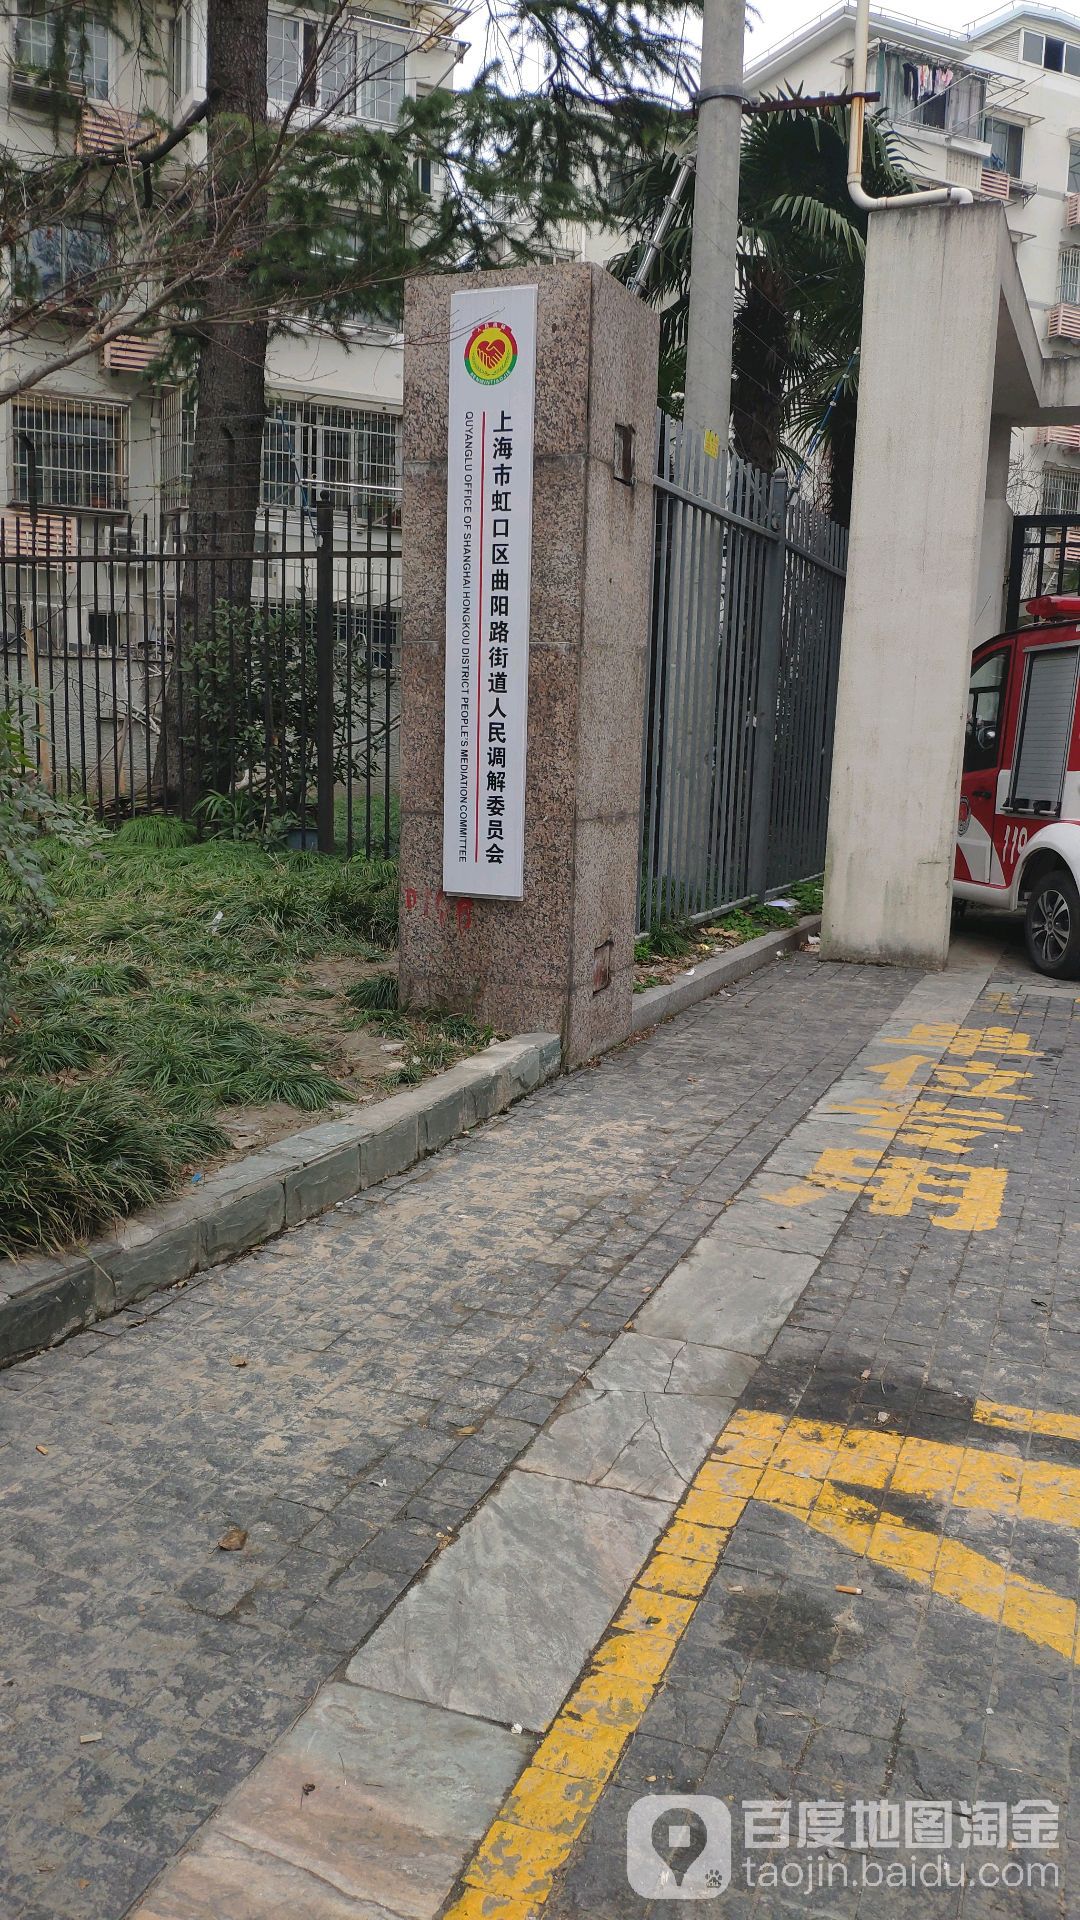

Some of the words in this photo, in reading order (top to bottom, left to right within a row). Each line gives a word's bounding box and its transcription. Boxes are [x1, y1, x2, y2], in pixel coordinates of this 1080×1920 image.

[464, 411, 474, 471] QUYANGLU
[463, 474, 473, 513] OFFICE
[463, 516, 472, 530] OF
[462, 533, 472, 588] SHANGHAI
[461, 591, 471, 645] HONGKOU
[486, 410, 513, 864] 上海市虹口区曲阳路街道人民调解委员会
[460, 648, 470, 694] DISTRICT
[459, 749, 469, 803] MEDIATION
[458, 805, 468, 863] COMMITTEE
